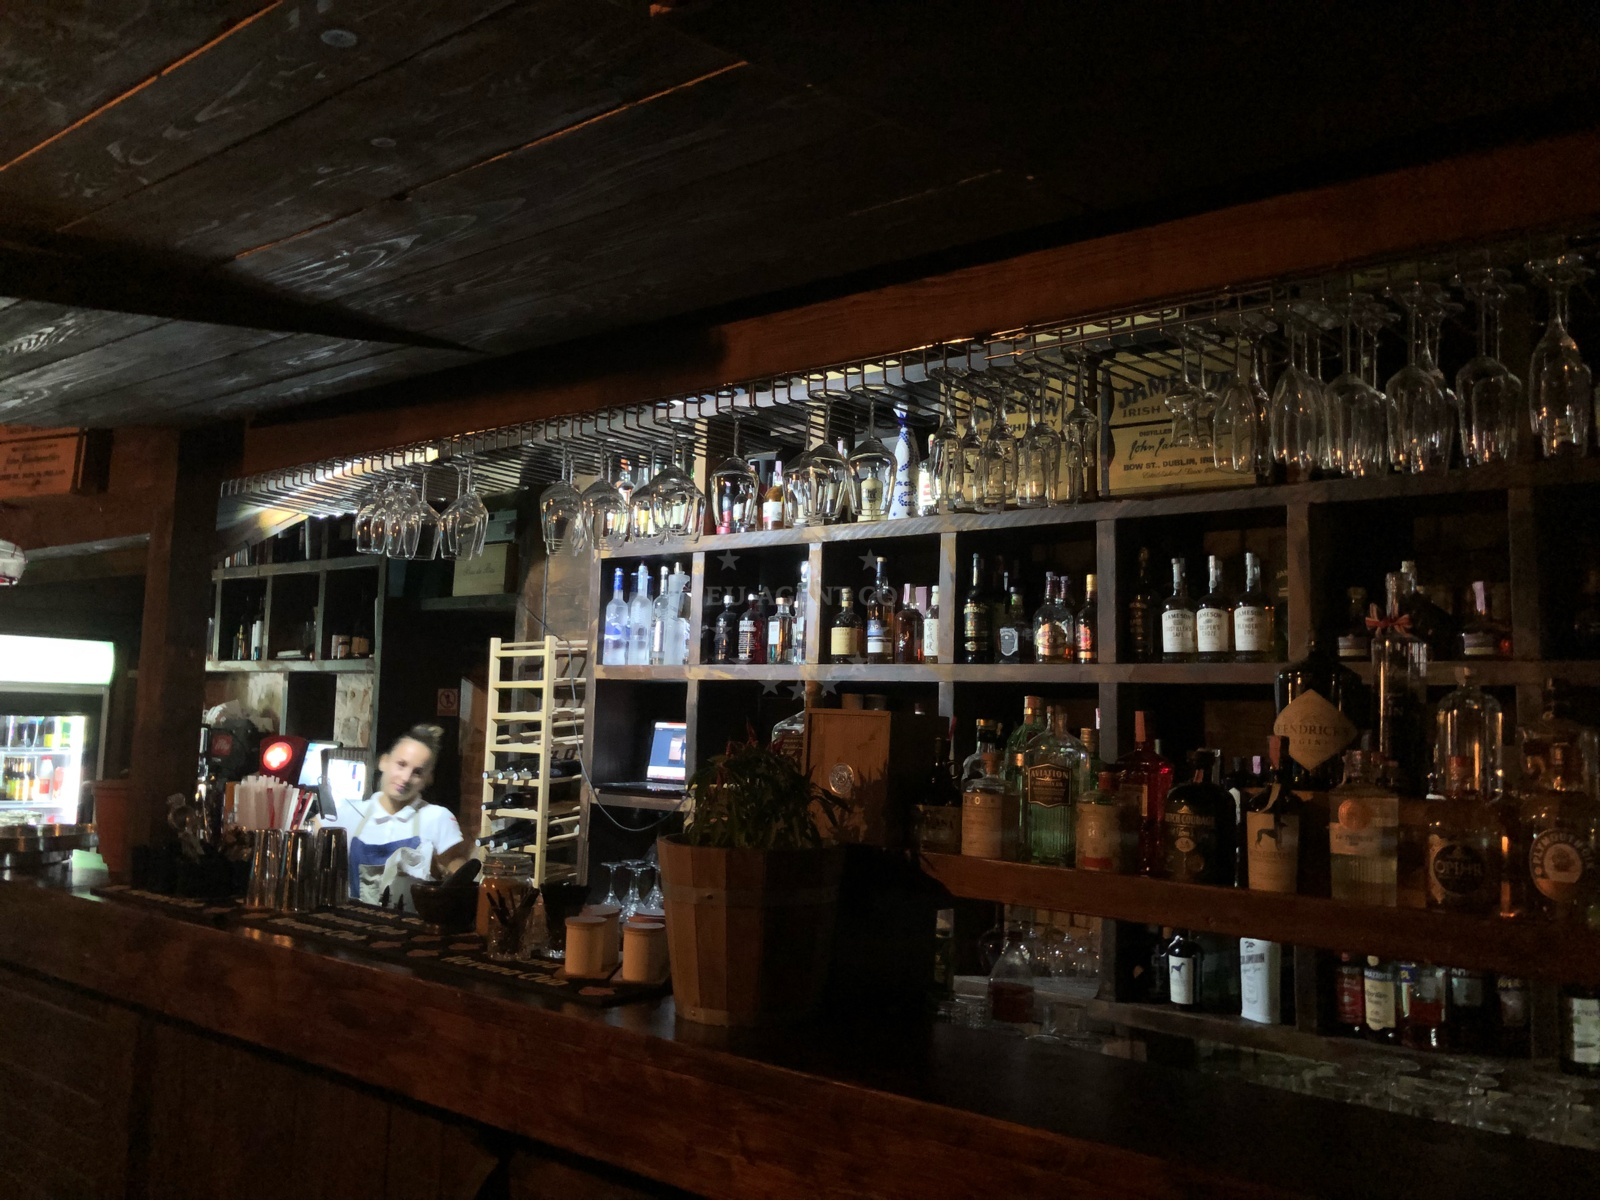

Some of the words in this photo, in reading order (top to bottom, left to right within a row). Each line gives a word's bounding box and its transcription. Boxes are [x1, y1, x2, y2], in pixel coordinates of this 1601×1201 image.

[1122, 405, 1160, 418] IRISH
[1129, 438, 1155, 460] John
[1123, 463, 1143, 471] BOW
[1165, 612, 1191, 621] JAMESON
[1198, 611, 1222, 619] JAMESON
[1030, 769, 1069, 780] AVIATION
